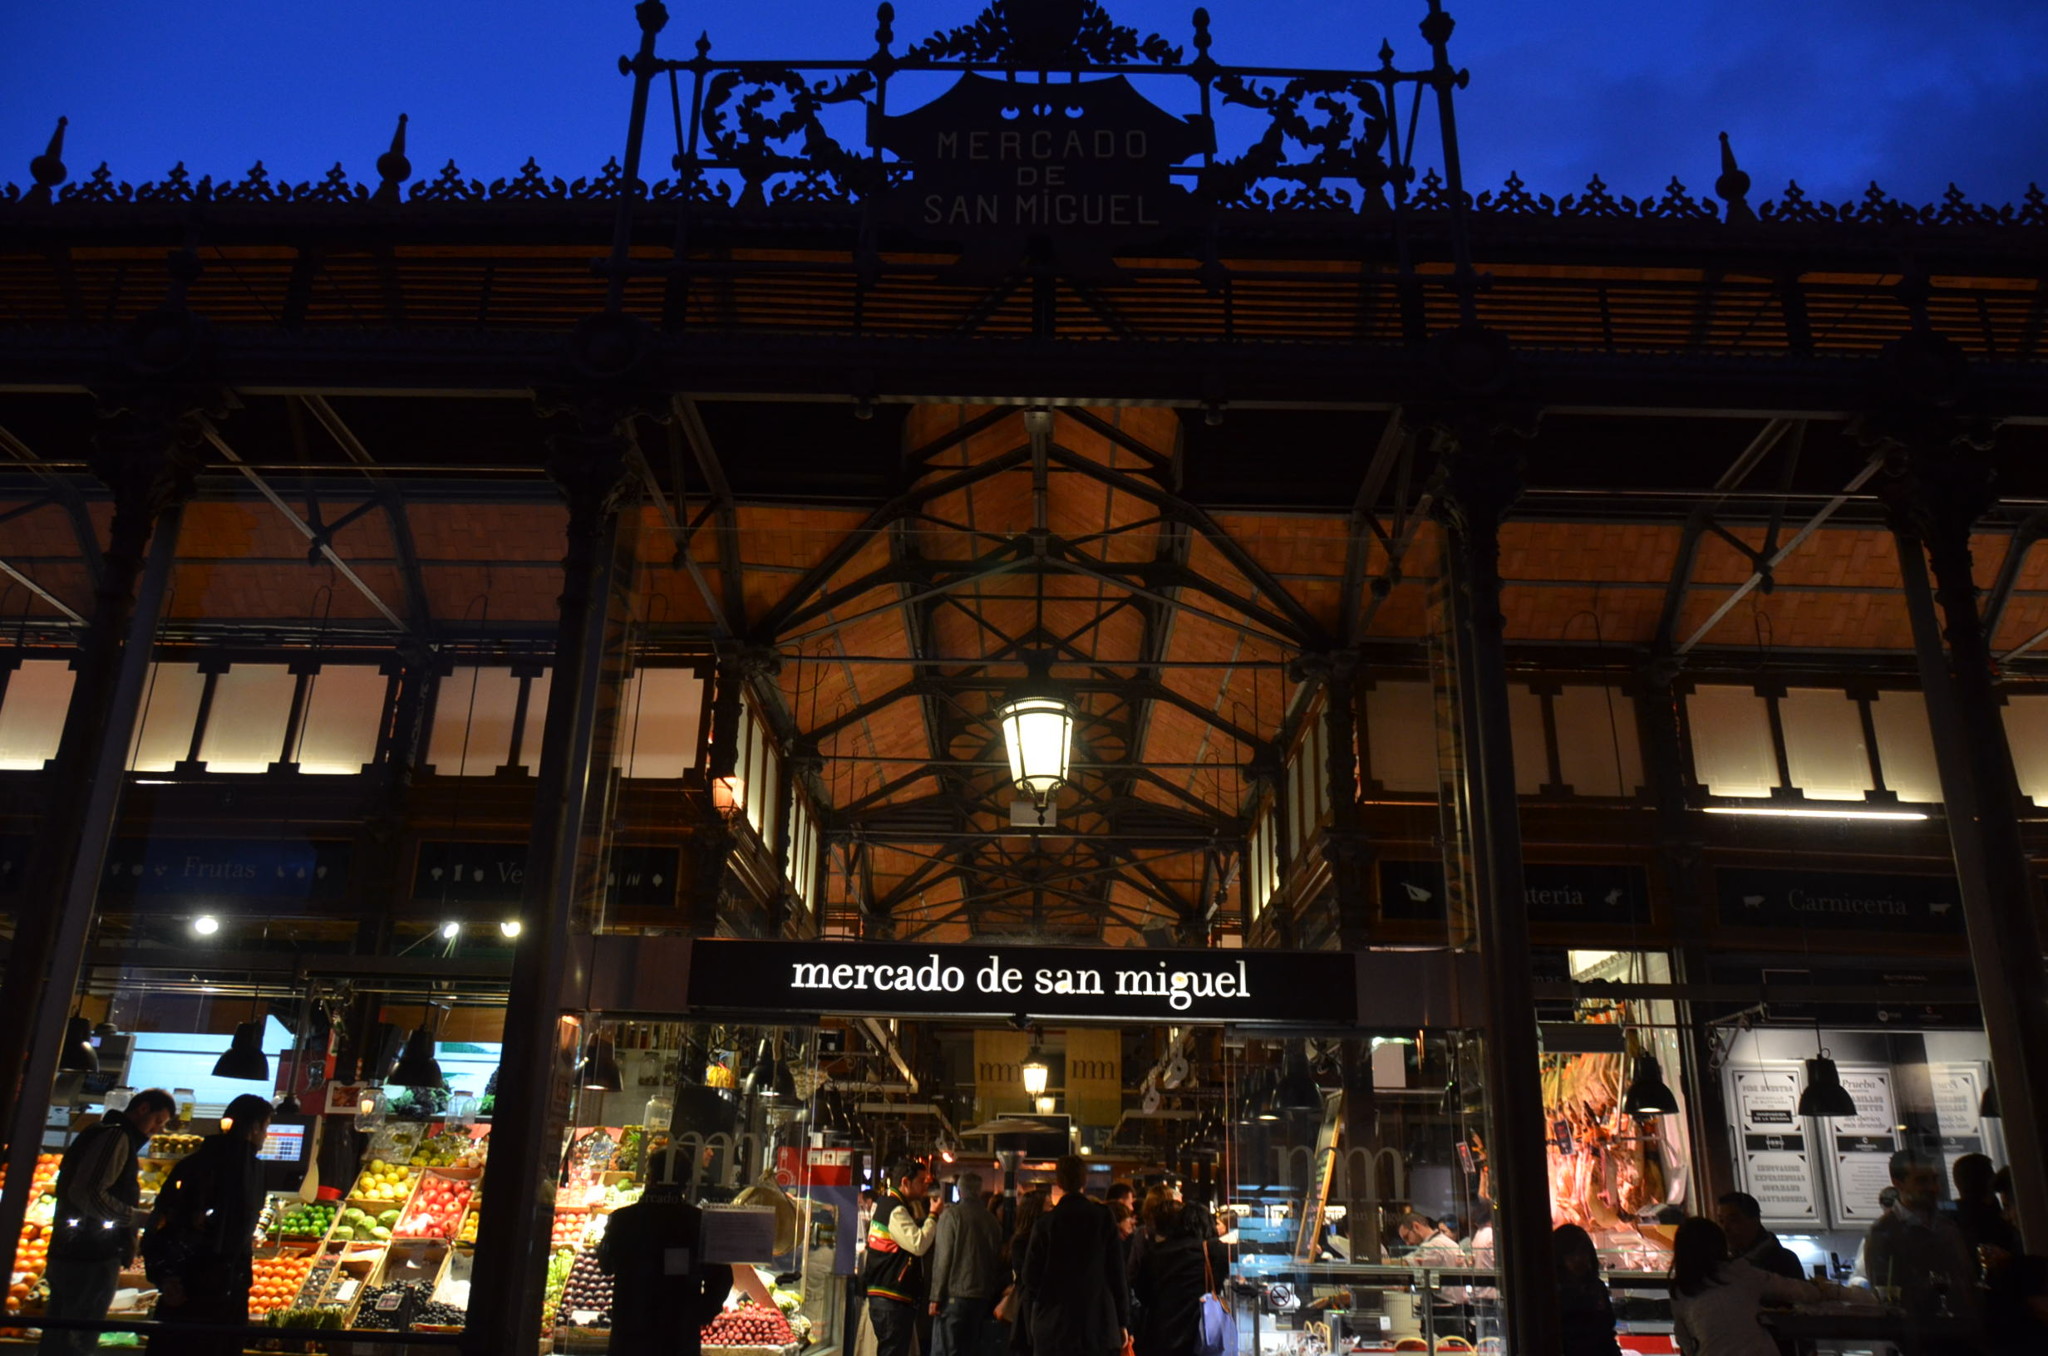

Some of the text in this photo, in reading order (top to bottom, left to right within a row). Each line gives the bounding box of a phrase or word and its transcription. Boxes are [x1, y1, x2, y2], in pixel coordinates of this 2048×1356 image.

[937, 129, 1148, 160] MERCADO
[1016, 166, 1066, 186] DE
[923, 194, 999, 225] SAN
[183, 855, 256, 878] Frutas
[496, 861, 524, 884] Ve
[1524, 883, 1586, 905] tería
[791, 953, 1251, 1011] mercado de san miguel
